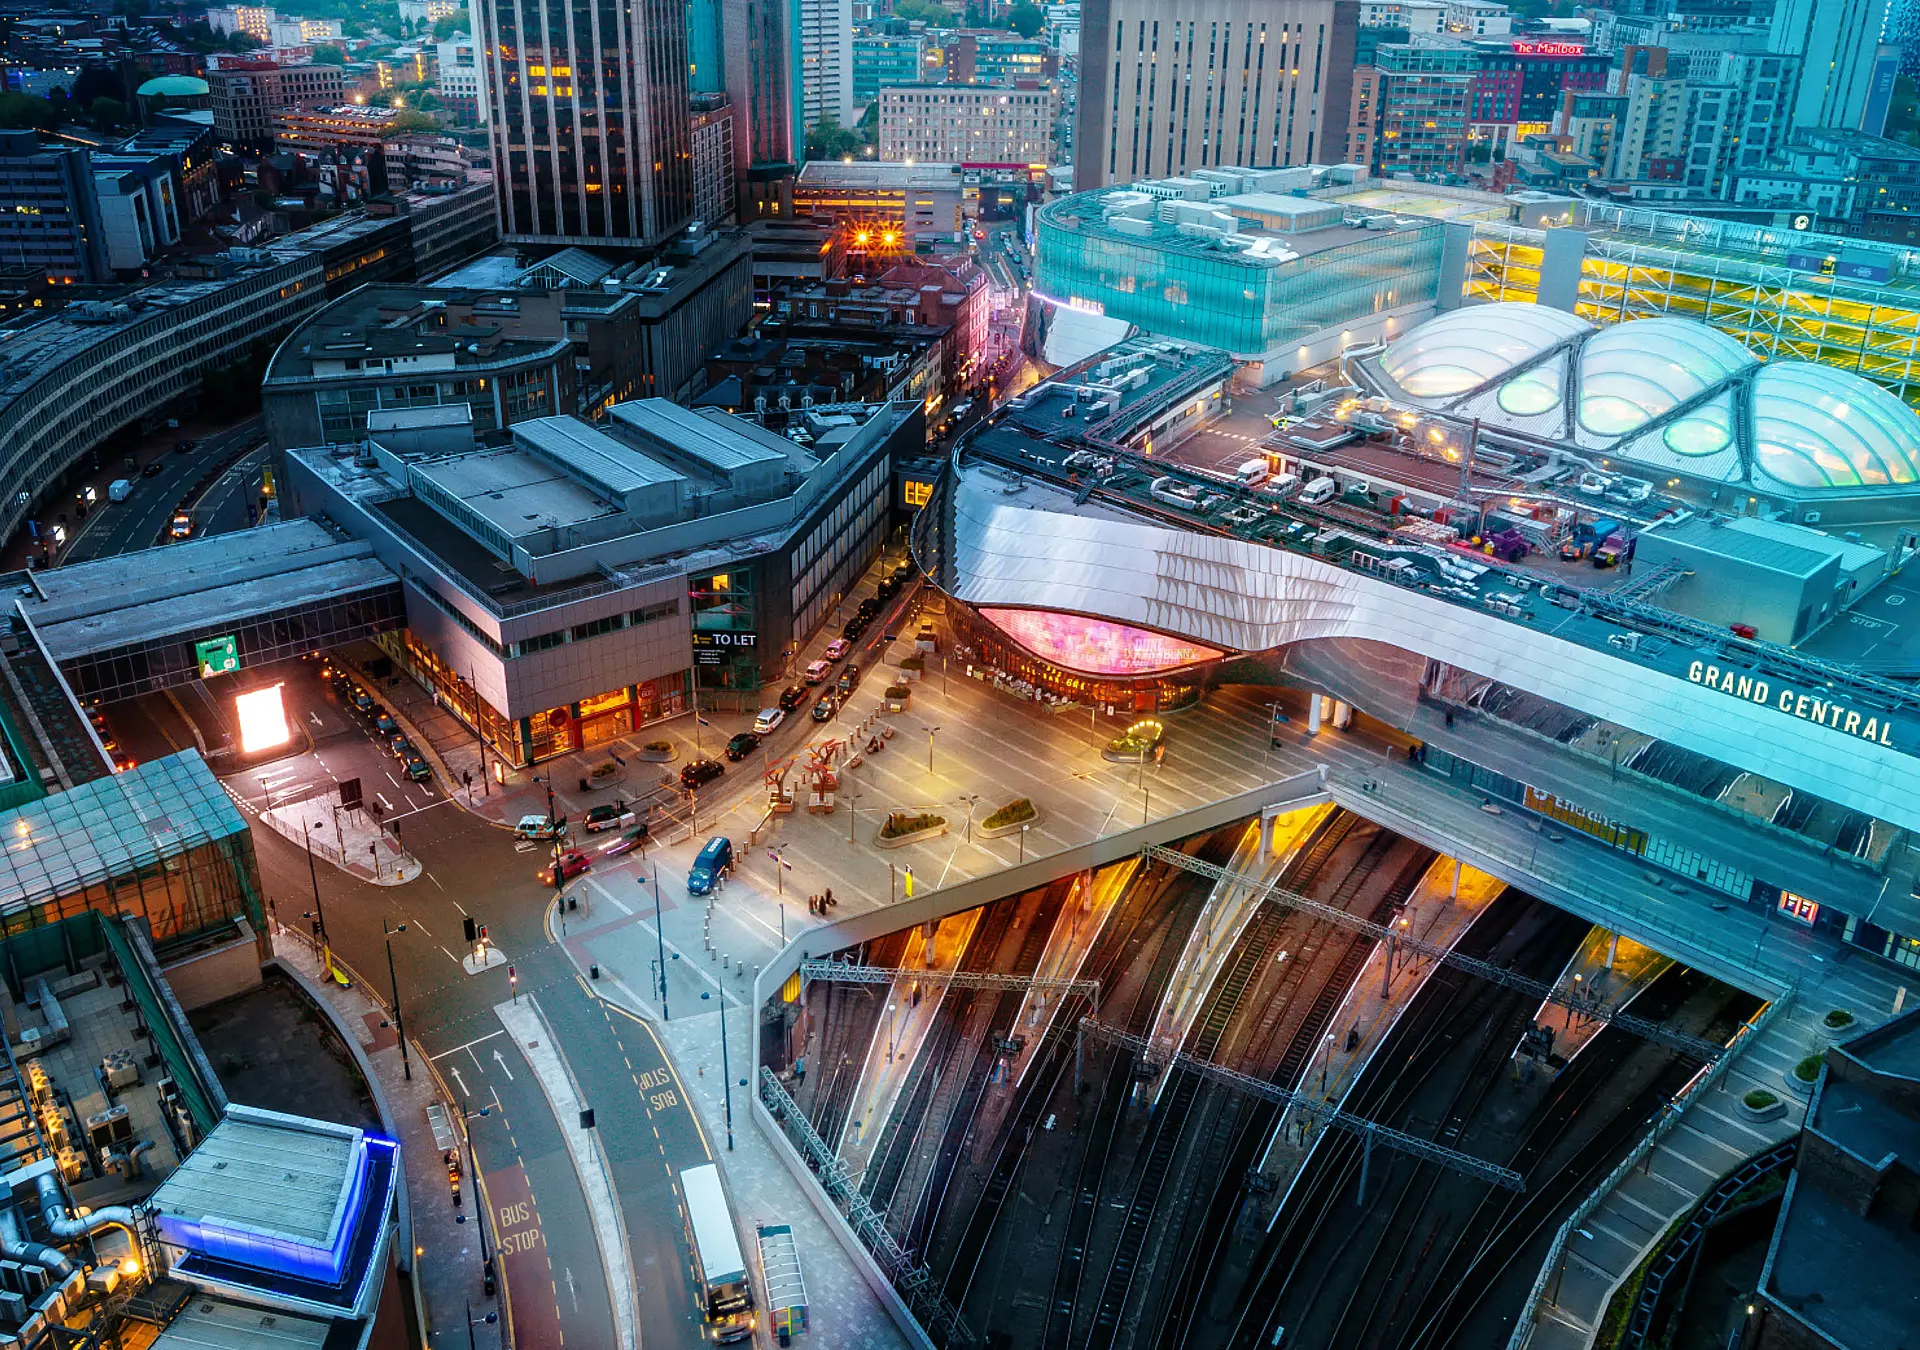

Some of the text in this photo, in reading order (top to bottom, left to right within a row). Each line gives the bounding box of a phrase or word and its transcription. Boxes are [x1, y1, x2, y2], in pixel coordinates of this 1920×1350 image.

[1536, 42, 1582, 54] Mailbox
[1850, 616, 1881, 628] STOP
[713, 634, 731, 645] TO
[733, 634, 756, 645] LET
[1688, 660, 1893, 746] GRAND CENTRAL
[640, 1068, 670, 1090] STOP
[651, 1089, 677, 1111] BUS
[500, 1202, 530, 1227] BUS
[503, 1229, 539, 1255] STOP
